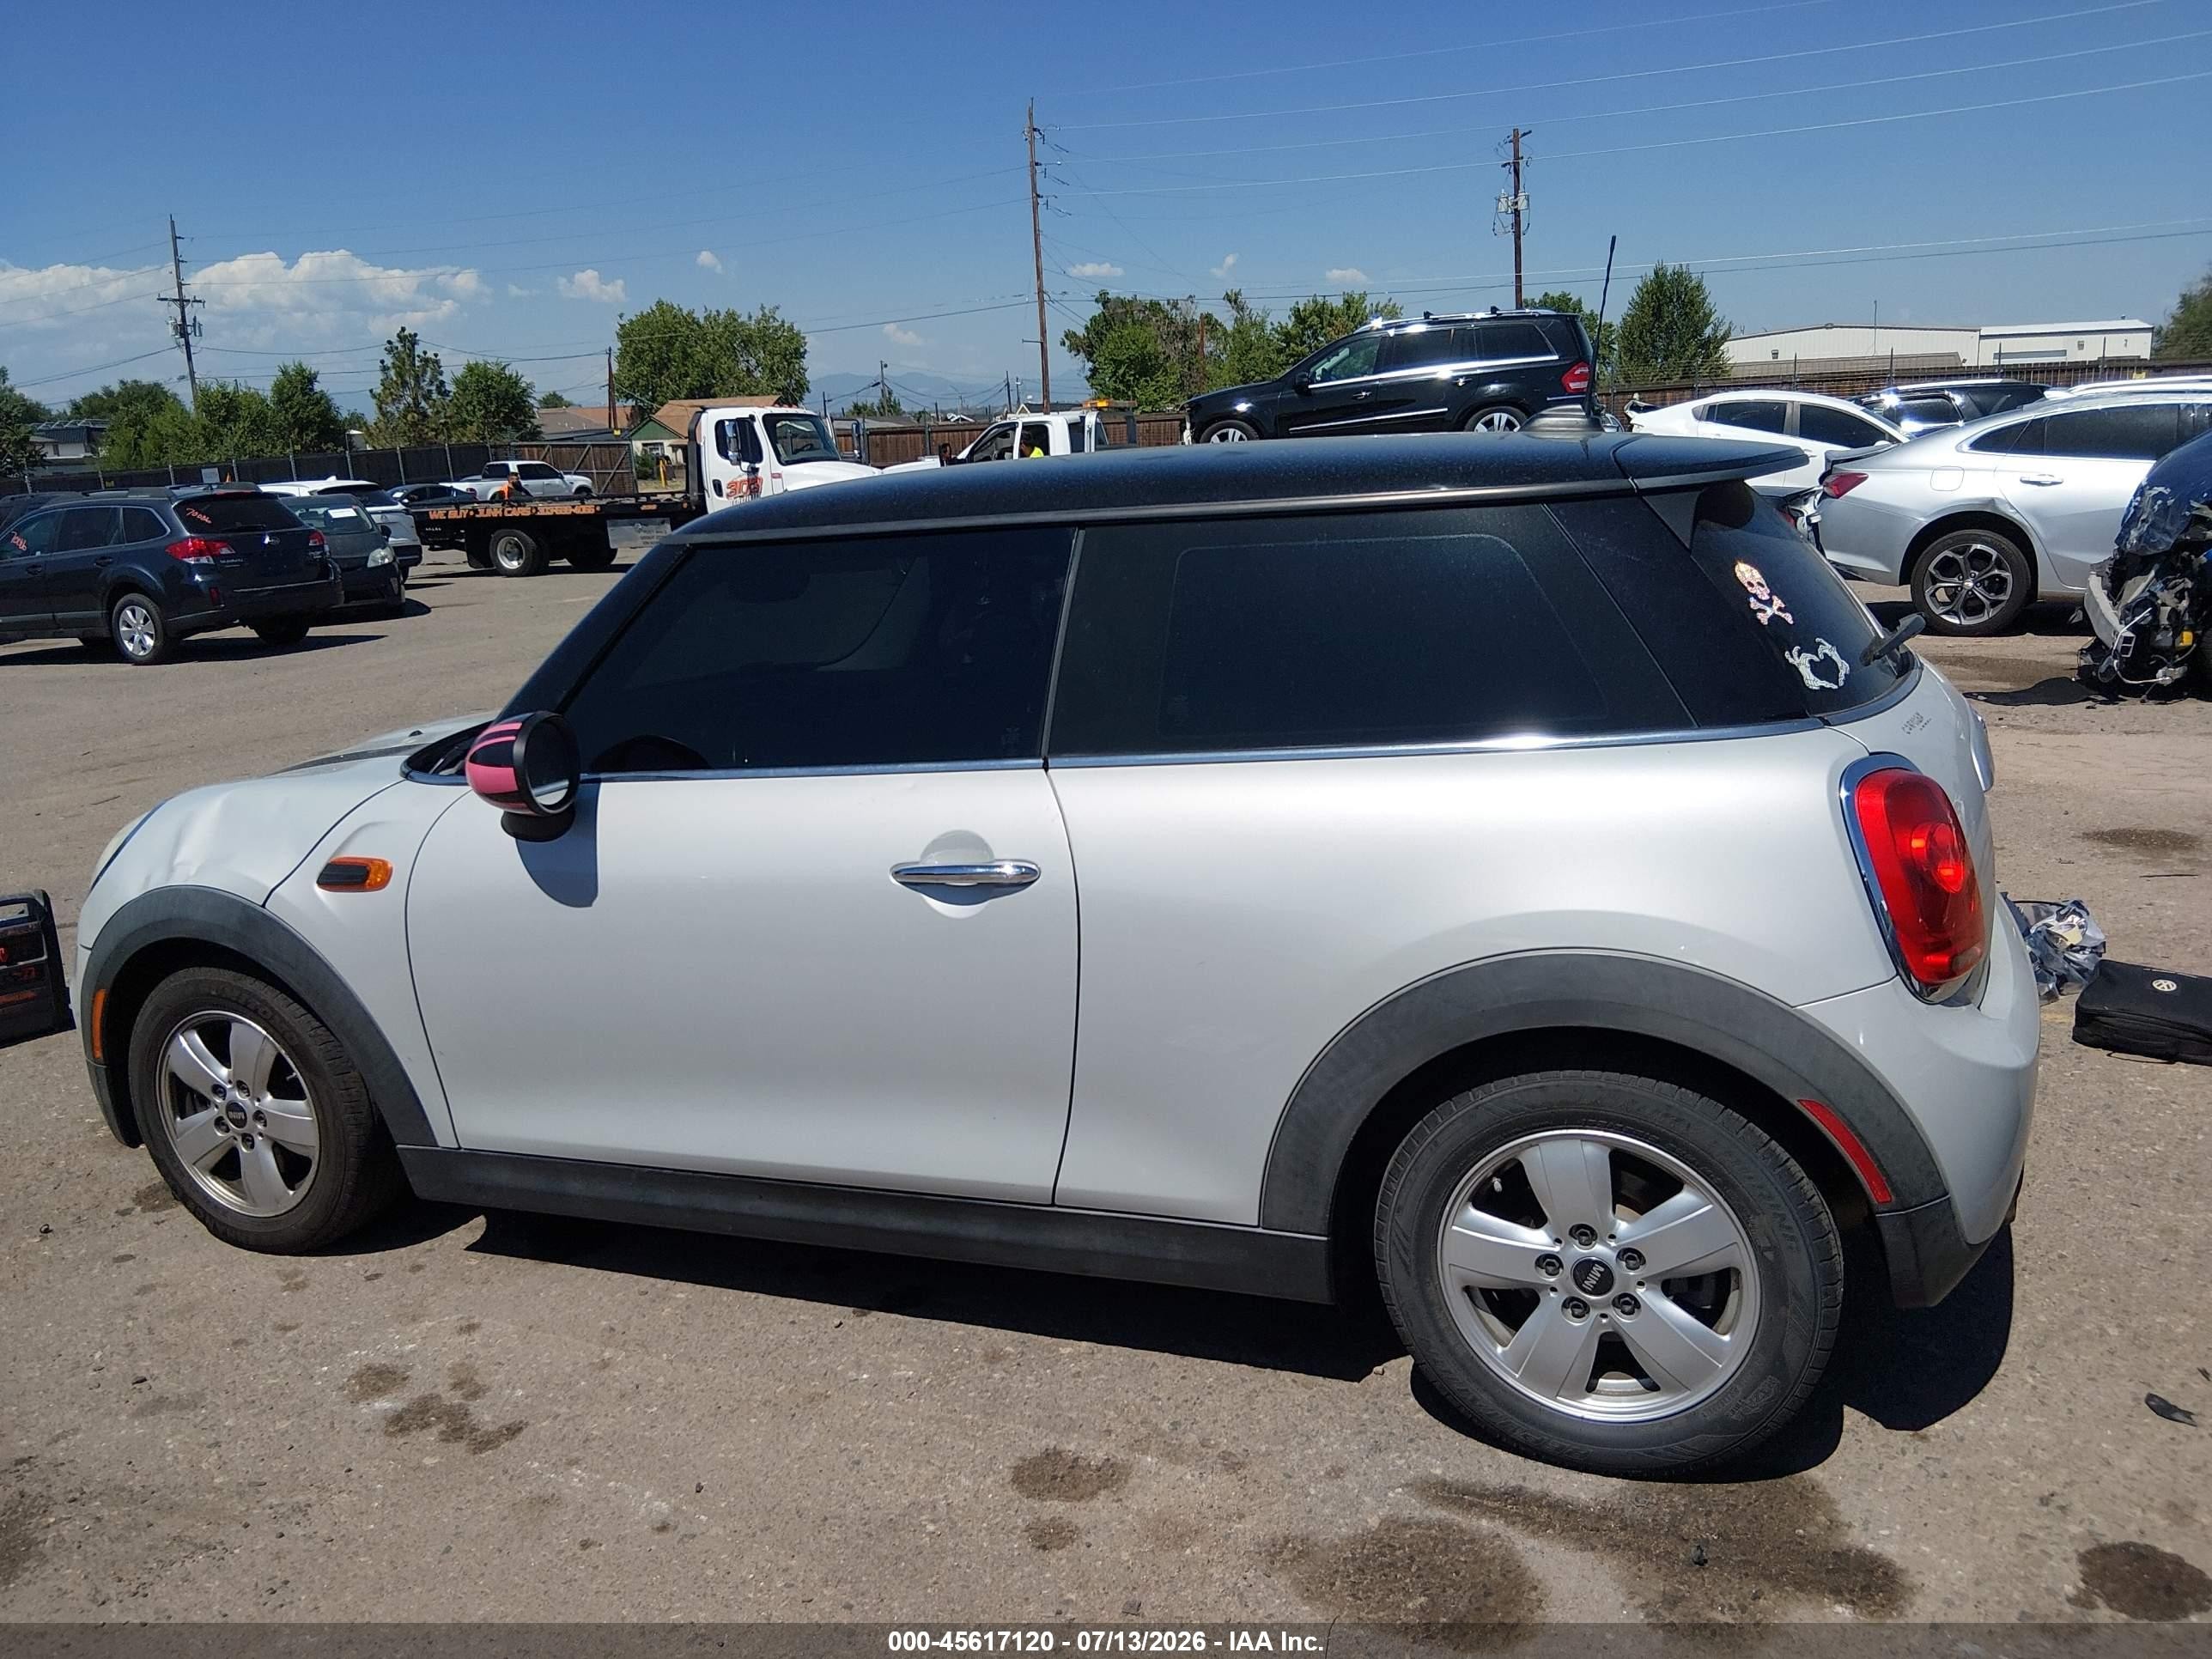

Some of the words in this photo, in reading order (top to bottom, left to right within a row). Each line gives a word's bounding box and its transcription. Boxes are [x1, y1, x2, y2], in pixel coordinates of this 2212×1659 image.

[428, 509, 447, 520] WE
[447, 508, 469, 520] BUY
[504, 507, 532, 517] CARS
[1581, 1263, 1606, 1291] MINI
